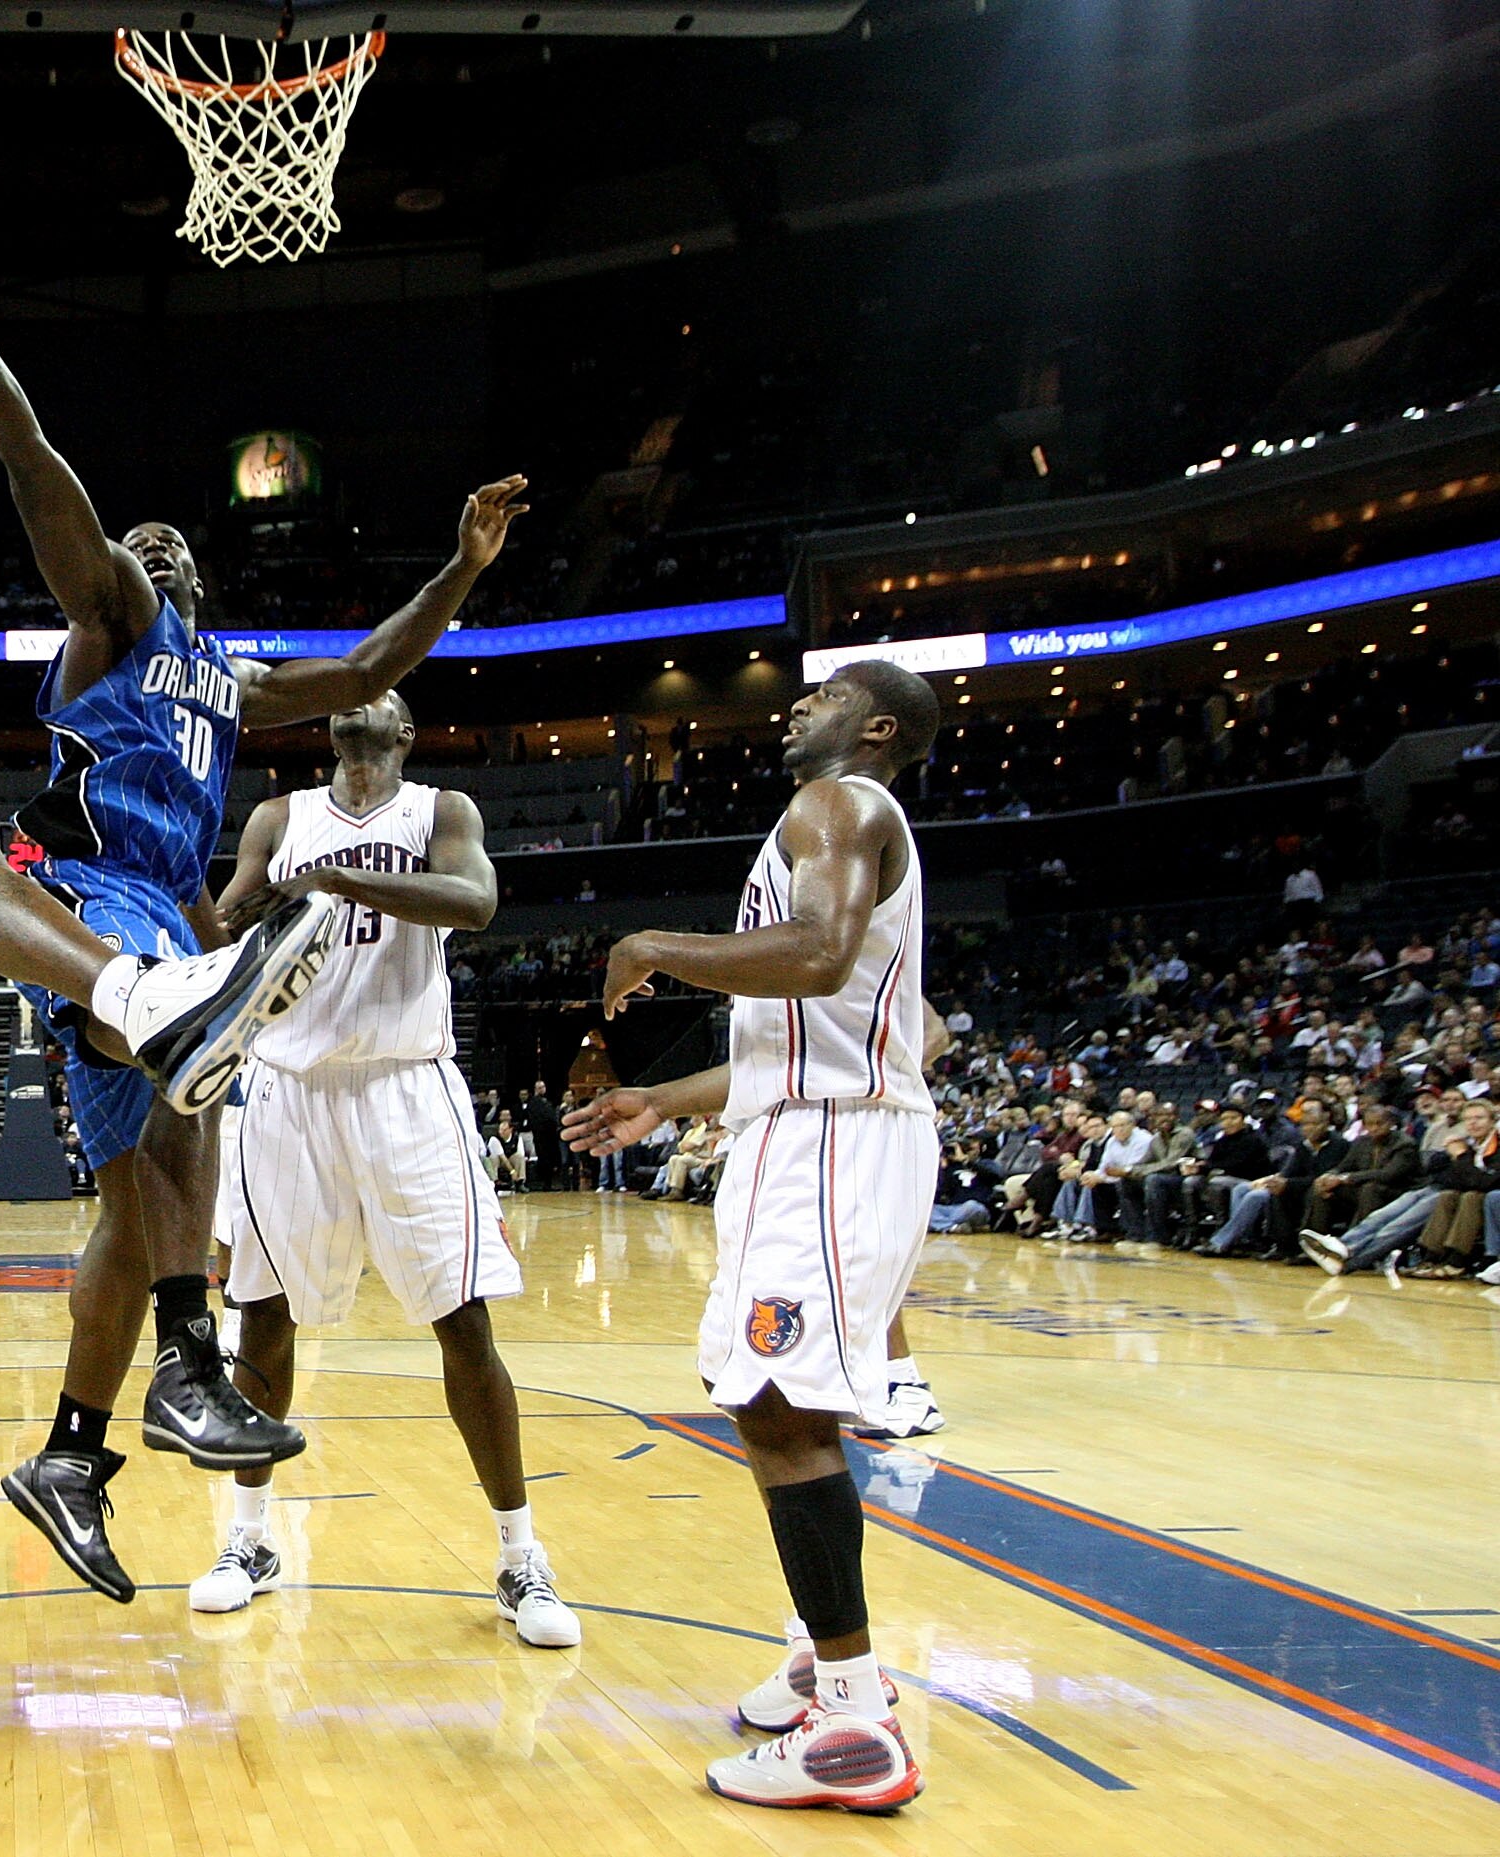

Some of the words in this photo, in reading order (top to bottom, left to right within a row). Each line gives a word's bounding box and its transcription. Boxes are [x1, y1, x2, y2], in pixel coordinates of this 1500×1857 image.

[224, 640, 258, 655] you
[1009, 630, 1064, 656] With
[1066, 631, 1108, 655] you
[142, 654, 238, 719] ORLAND
[174, 704, 212, 782] 30
